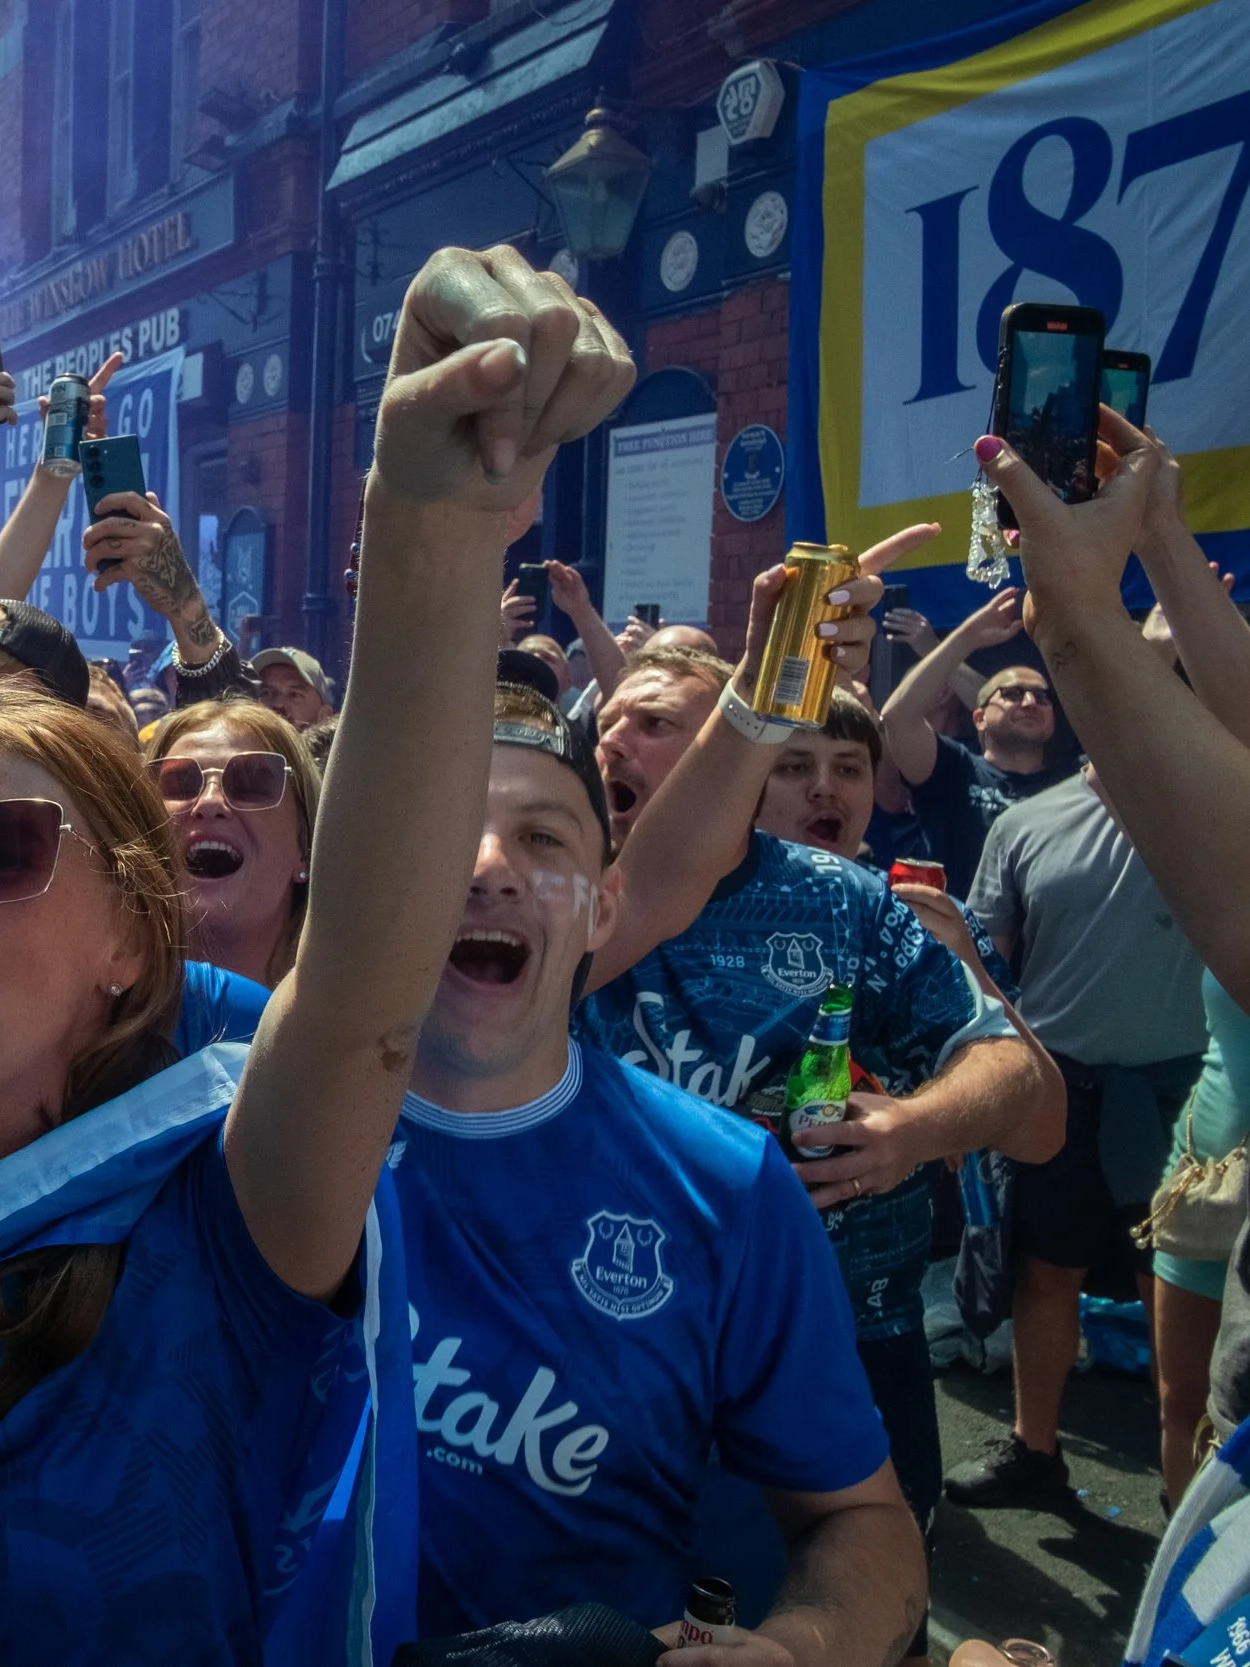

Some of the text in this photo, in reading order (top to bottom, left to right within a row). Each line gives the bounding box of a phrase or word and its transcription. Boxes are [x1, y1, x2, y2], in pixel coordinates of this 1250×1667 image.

[117, 211, 191, 280] HOTEL
[22, 365, 51, 398] THE
[138, 307, 180, 357] PUB
[118, 389, 154, 436] GO
[62, 573, 146, 638] BOYS
[710, 953, 746, 968] 1928
[777, 967, 817, 979] Everton
[621, 991, 770, 1108] Stak
[595, 1265, 648, 1289] Everton
[409, 1302, 610, 1497] take
[426, 1447, 483, 1476] .com
